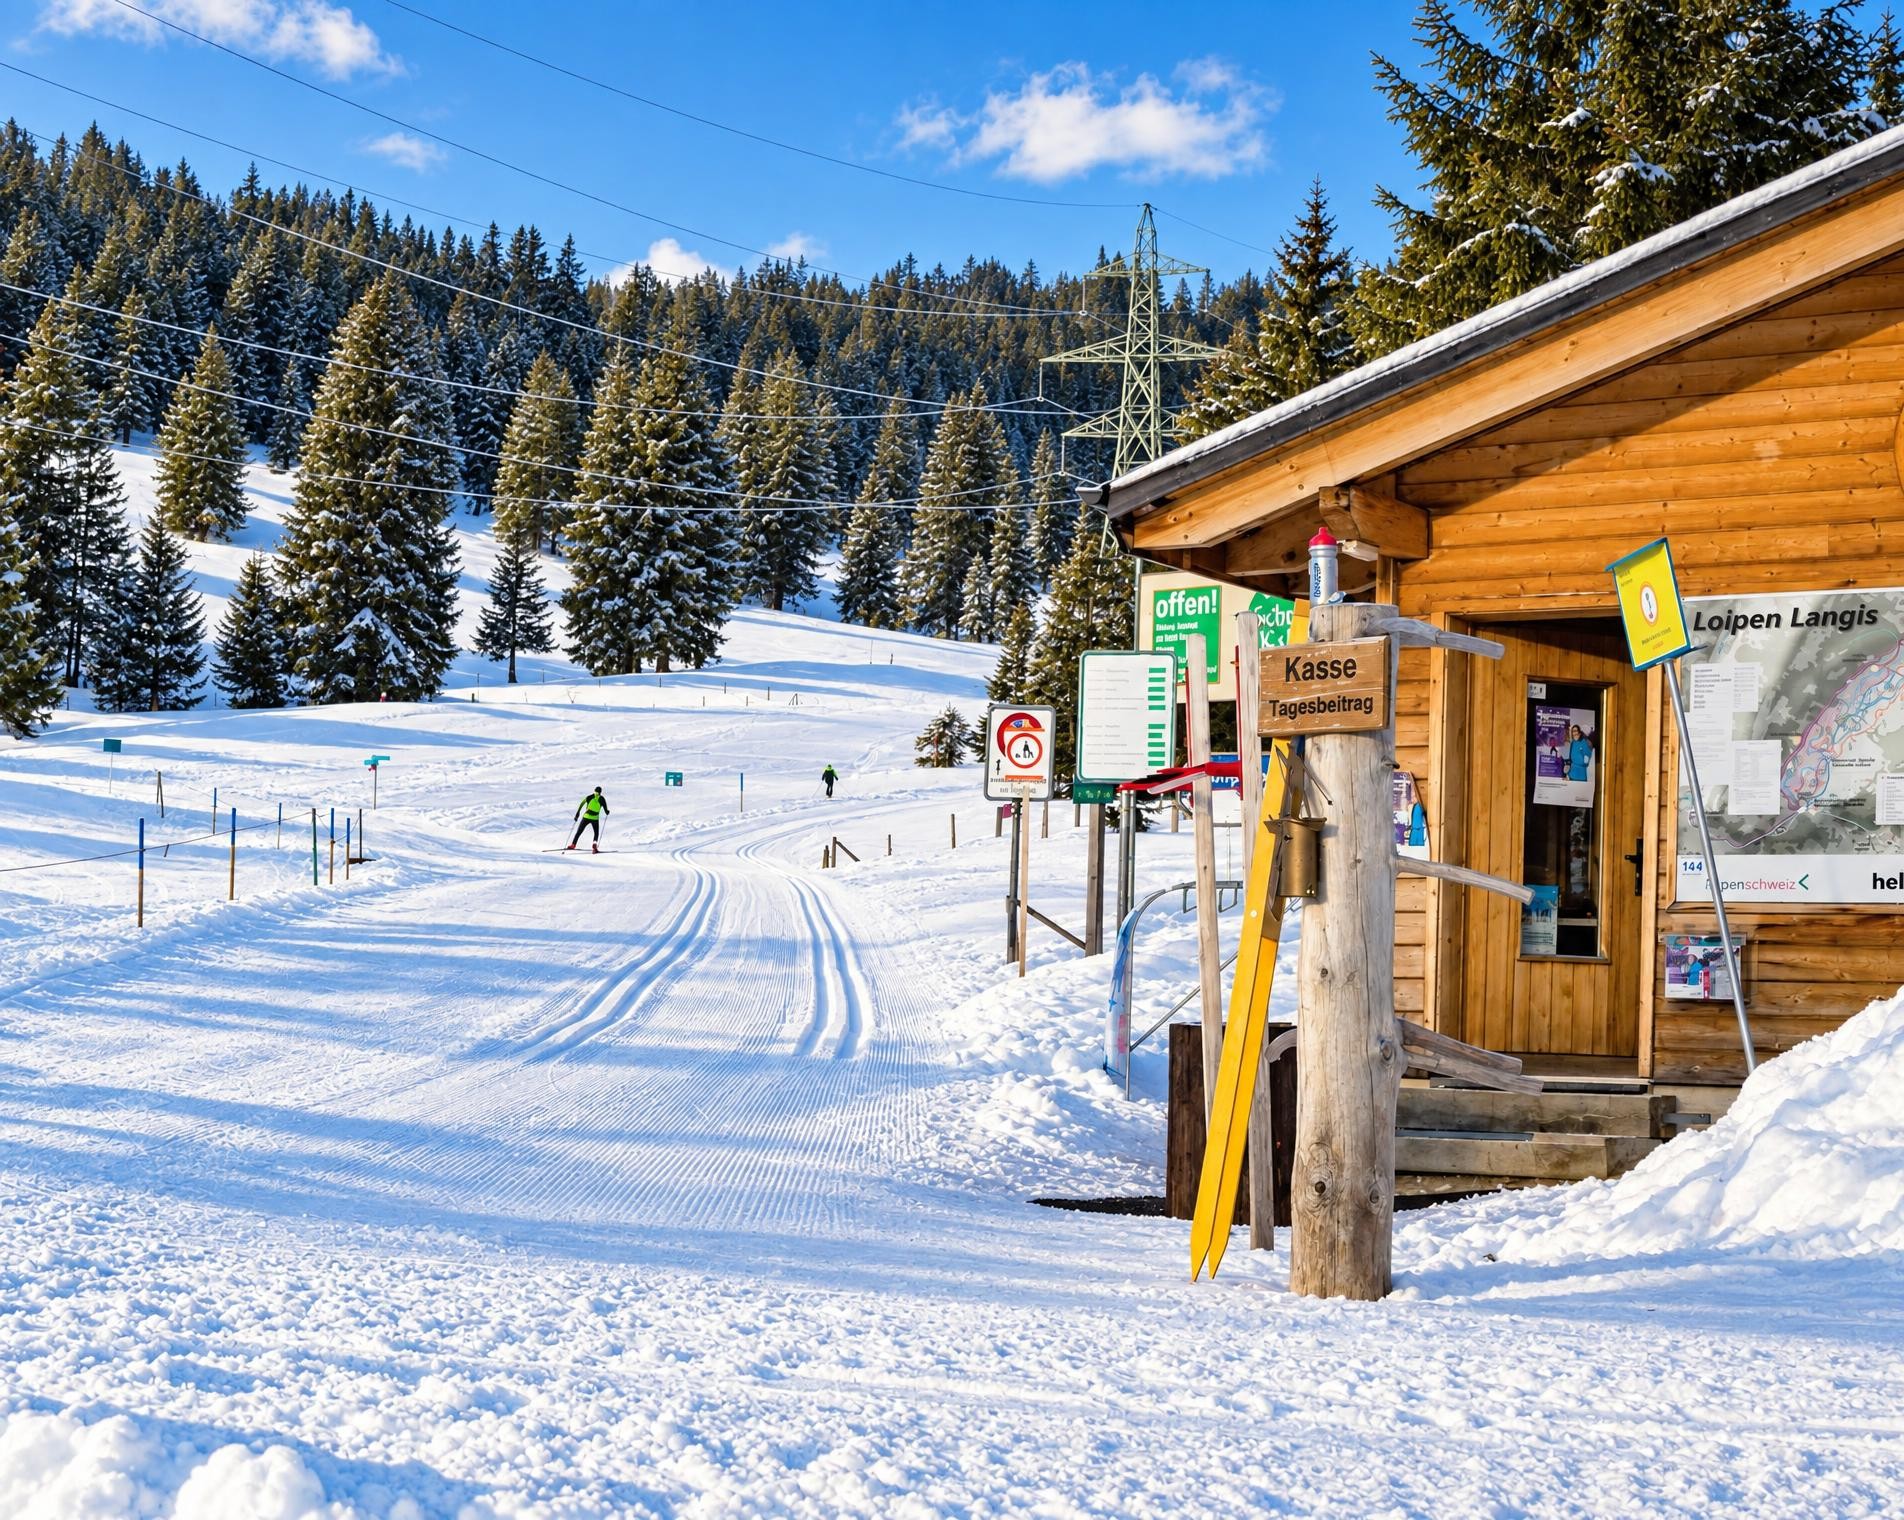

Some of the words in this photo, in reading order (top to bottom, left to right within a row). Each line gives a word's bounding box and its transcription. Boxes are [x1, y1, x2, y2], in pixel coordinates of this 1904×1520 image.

[1155, 589, 1218, 619] offen!
[1693, 609, 1782, 636] Loipen
[1790, 603, 1879, 632] Langis
[1285, 656, 1357, 683] Kasse
[1269, 695, 1374, 720] Tagesbeitrag
[1682, 861, 1703, 872] 144
[1872, 871, 1904, 890] hel
